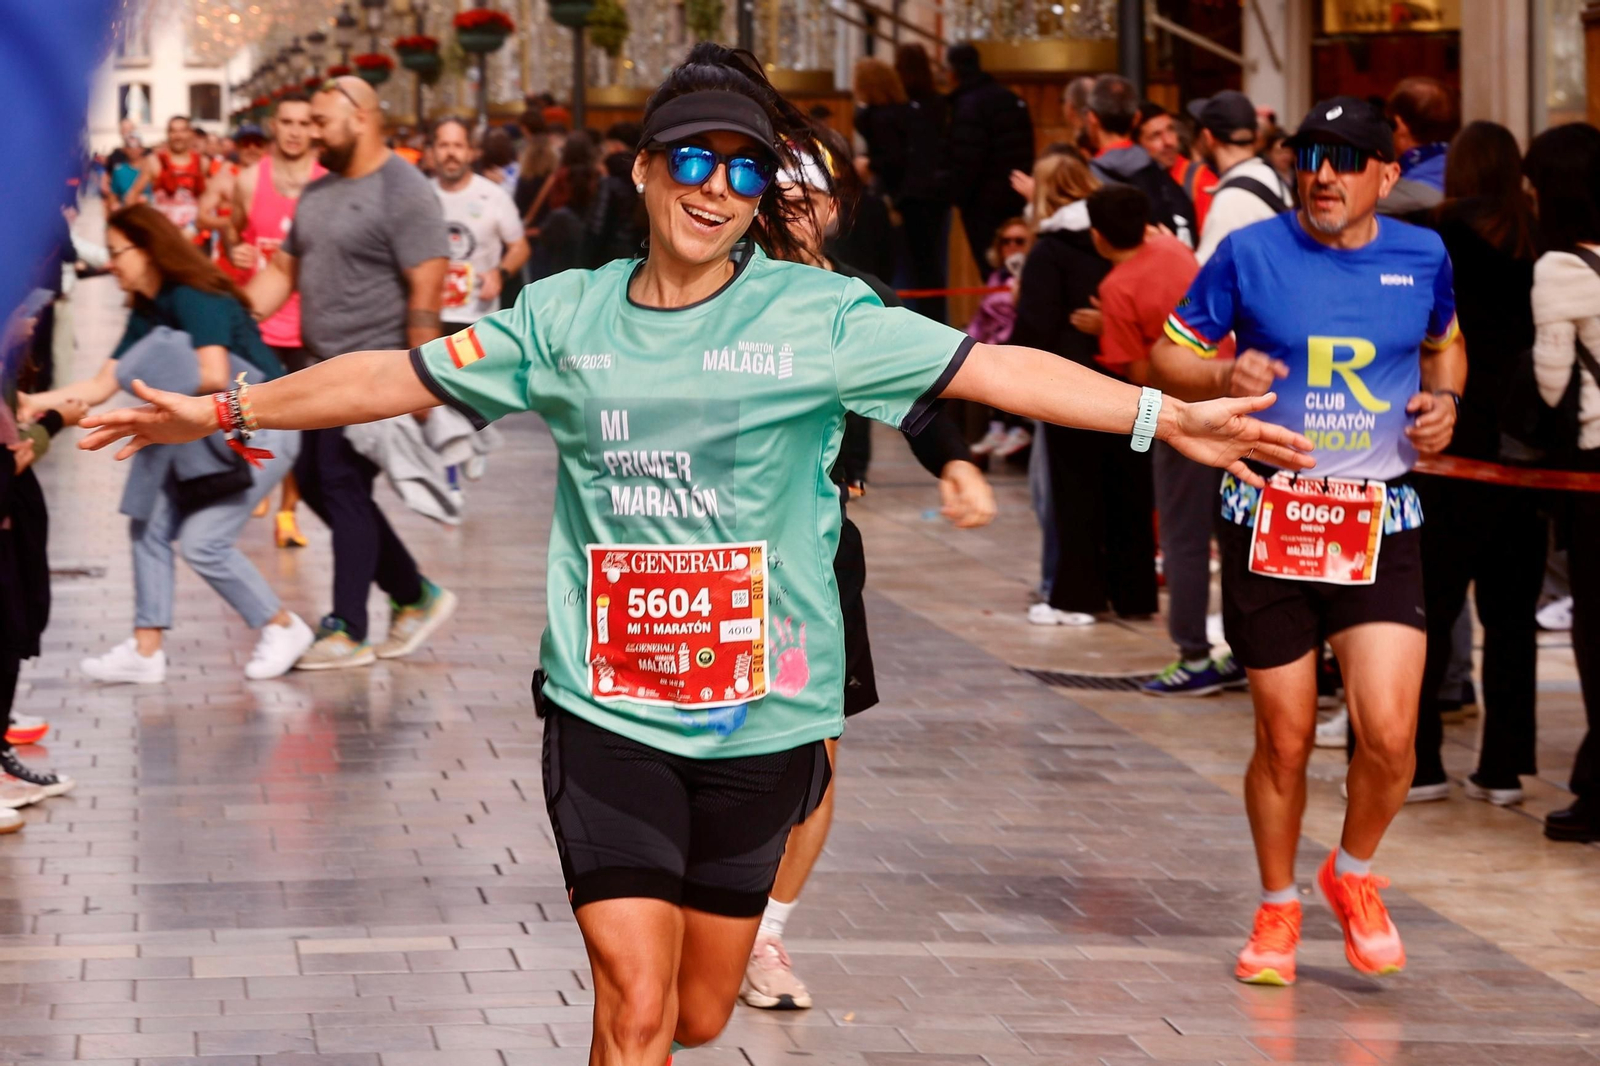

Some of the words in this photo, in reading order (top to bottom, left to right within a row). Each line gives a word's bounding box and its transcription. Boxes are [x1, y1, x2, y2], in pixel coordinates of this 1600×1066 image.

[738, 341, 774, 354] MARATÓN
[702, 345, 776, 376] MÁLAGA
[1307, 335, 1392, 413] R
[1305, 392, 1346, 410] CLUB
[600, 409, 630, 442] MI
[1304, 410, 1376, 431] MARATÓN
[603, 450, 692, 482] PRIMER
[610, 483, 721, 519] MARATÓN
[1285, 500, 1346, 525] 6060
[630, 550, 738, 574] GENERALI
[627, 587, 712, 619] 5604
[627, 623, 641, 635] MI
[644, 623, 650, 635] 1
[653, 619, 712, 635] MARATÓN
[728, 626, 753, 636] 4010
[637, 657, 677, 675] MÁLAGA
